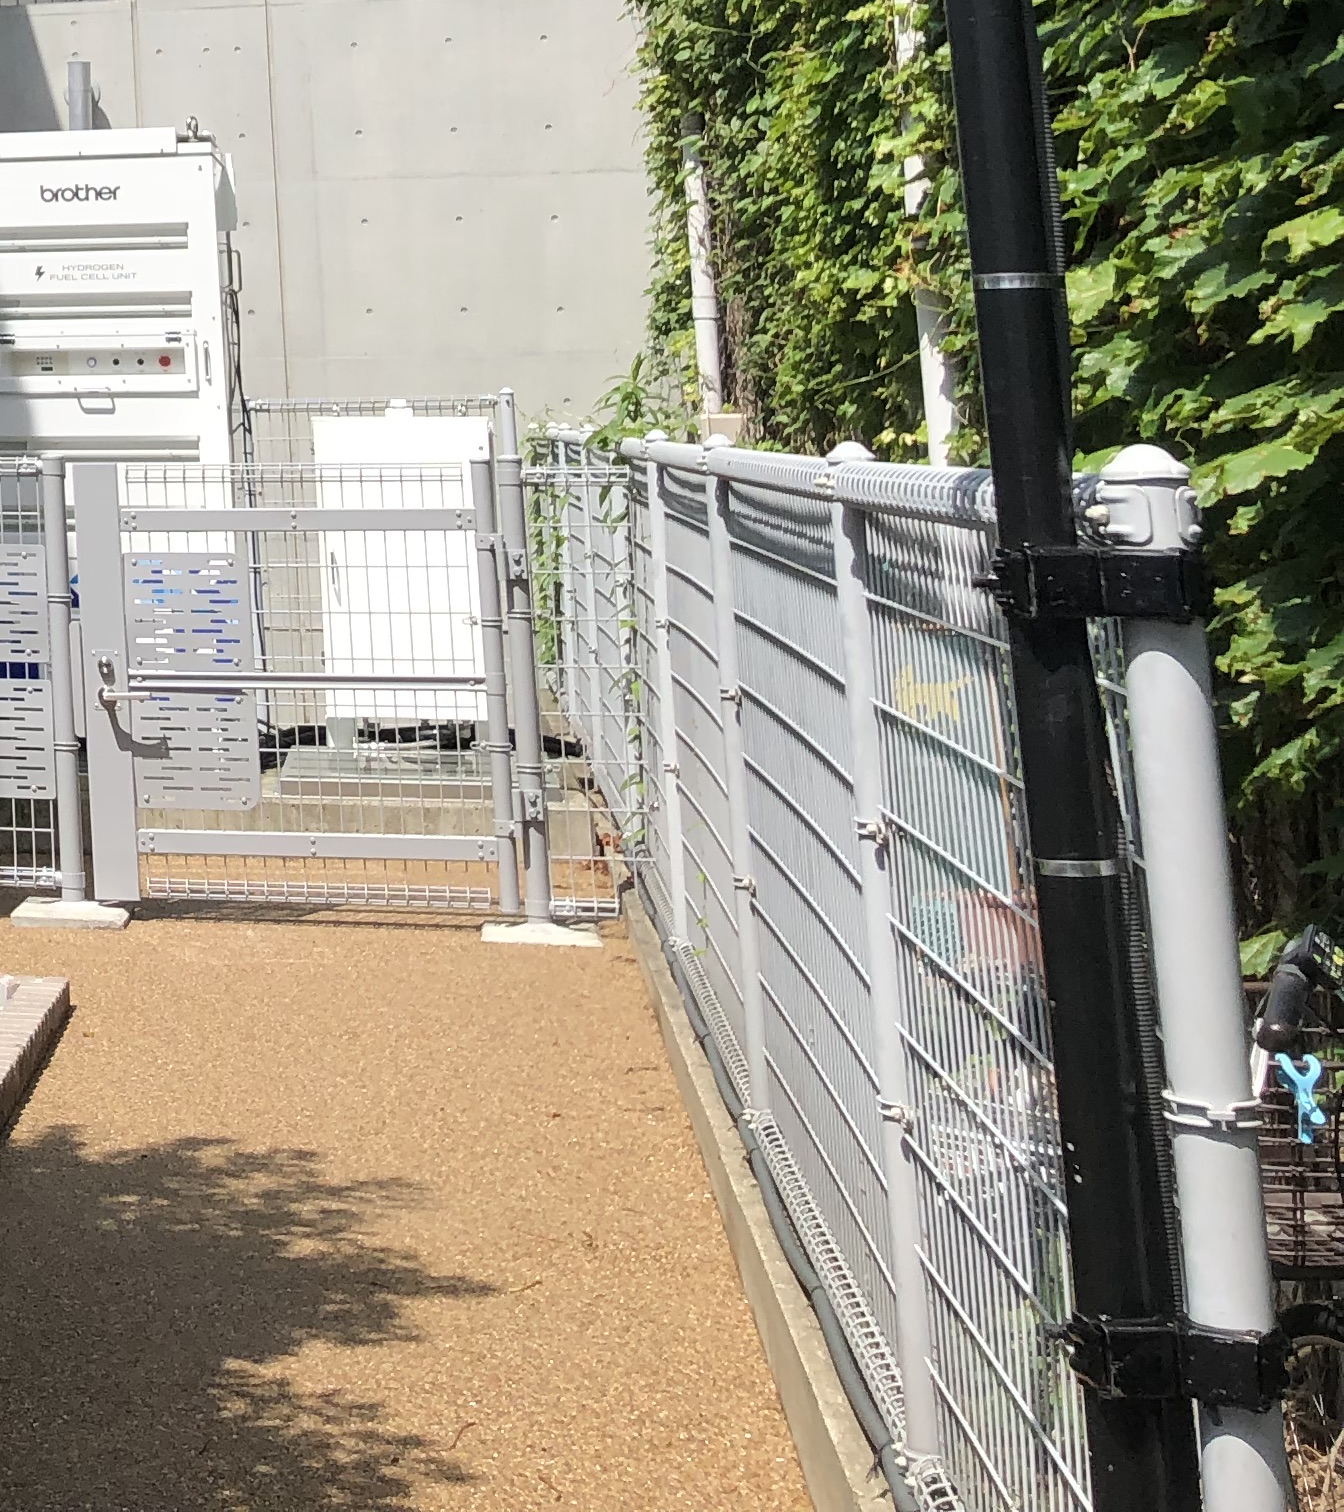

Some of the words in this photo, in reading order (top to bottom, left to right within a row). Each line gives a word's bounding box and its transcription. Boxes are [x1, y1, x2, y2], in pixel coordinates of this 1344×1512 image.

[40, 183, 120, 202] brother
[62, 264, 124, 272] HYDROGEN
[81, 273, 109, 281] CELL
[112, 272, 137, 280] UNIT
